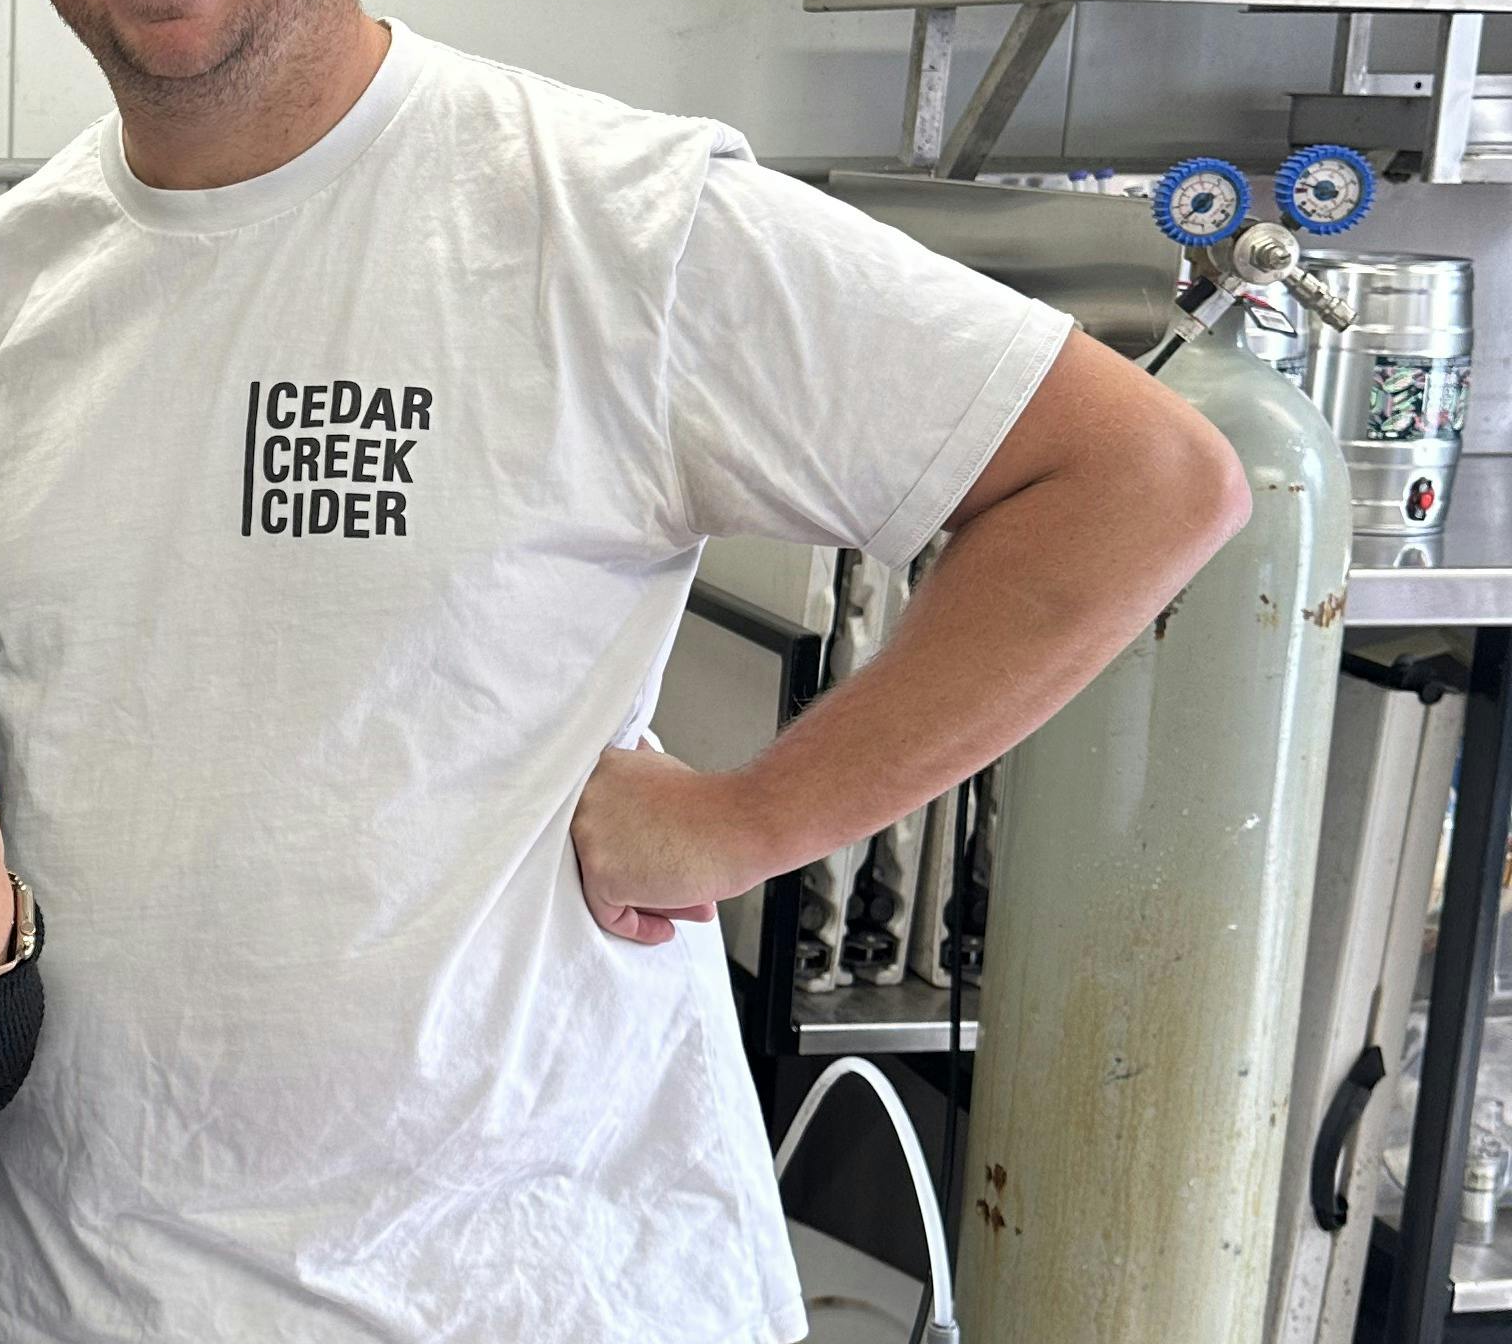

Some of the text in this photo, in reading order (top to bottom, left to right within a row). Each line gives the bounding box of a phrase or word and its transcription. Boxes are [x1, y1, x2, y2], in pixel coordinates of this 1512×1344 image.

[266, 380, 433, 432] CEDAR
[263, 434, 418, 484] CREEK
[261, 488, 407, 539] CIDER
